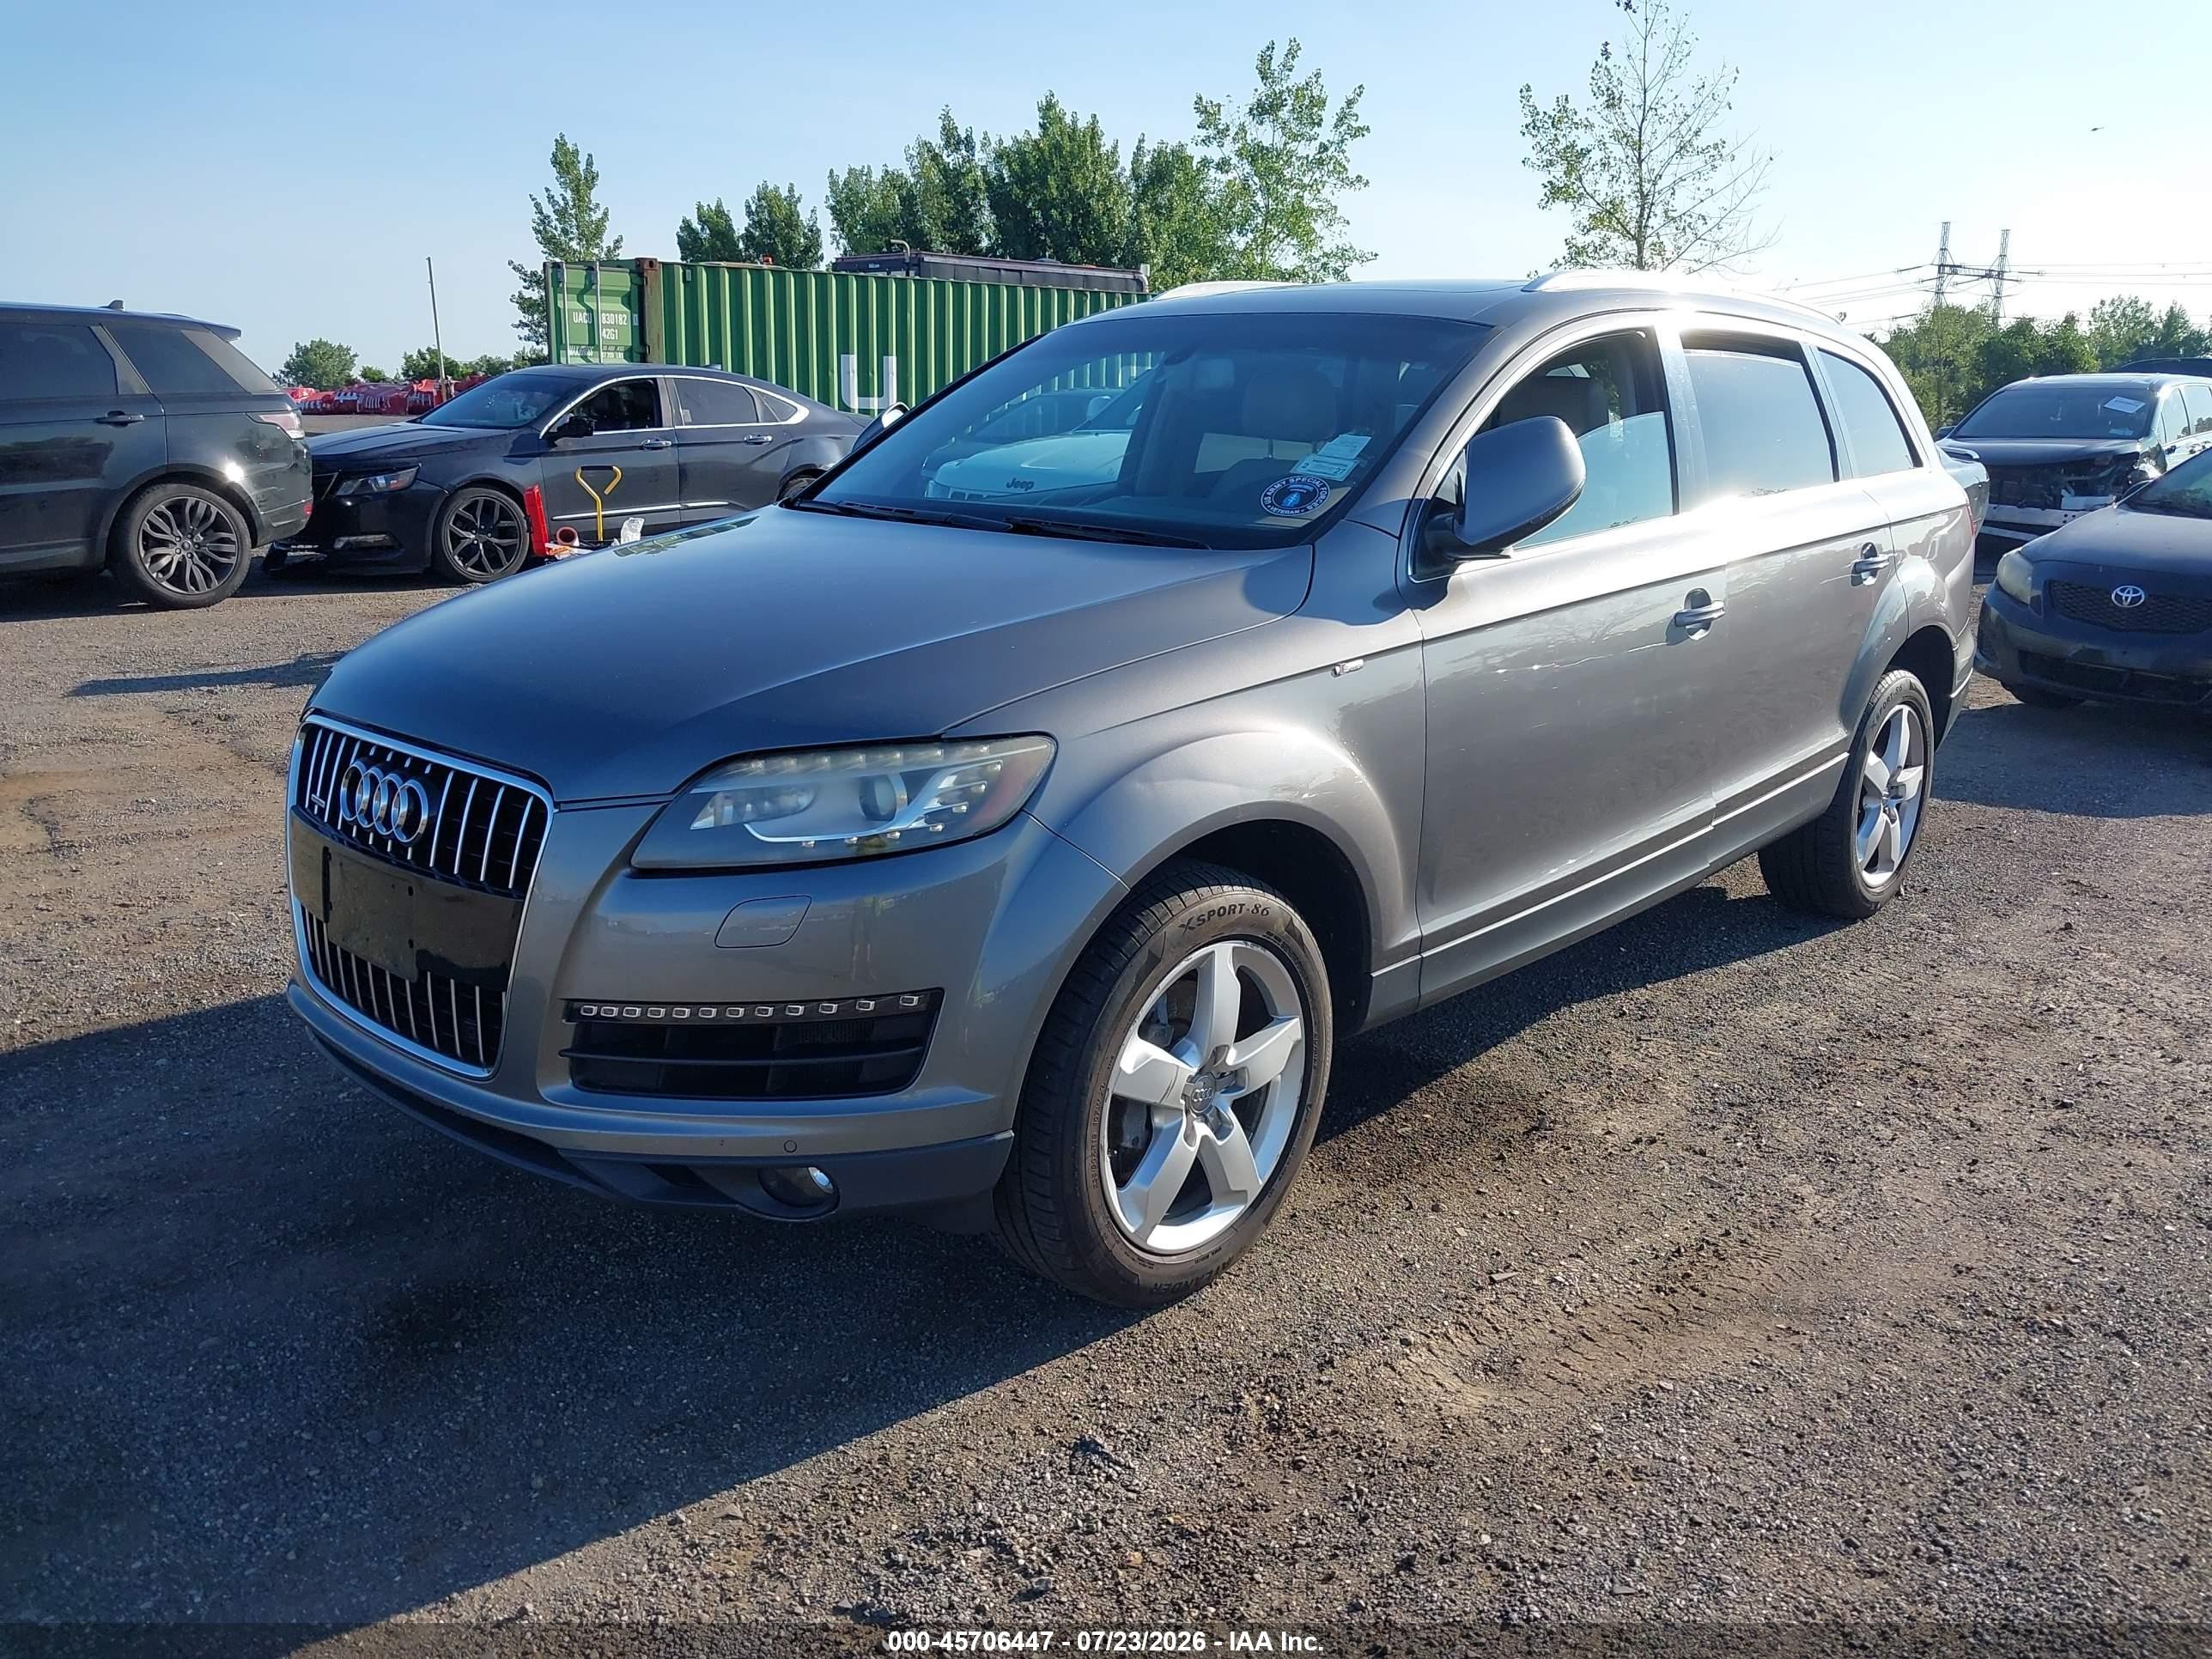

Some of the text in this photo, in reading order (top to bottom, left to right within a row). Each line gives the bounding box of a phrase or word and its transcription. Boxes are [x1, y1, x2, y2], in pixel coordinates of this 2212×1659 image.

[573, 312, 592, 324] UACU
[602, 313, 628, 325] 830182
[602, 328, 618, 340] 42G1
[1006, 477, 1035, 492] Jeep
[1266, 481, 1286, 495] ARMY
[1289, 477, 1323, 488] SPECIAL
[1306, 487, 1328, 510] FORCES
[1270, 506, 1300, 514] VETERAN
